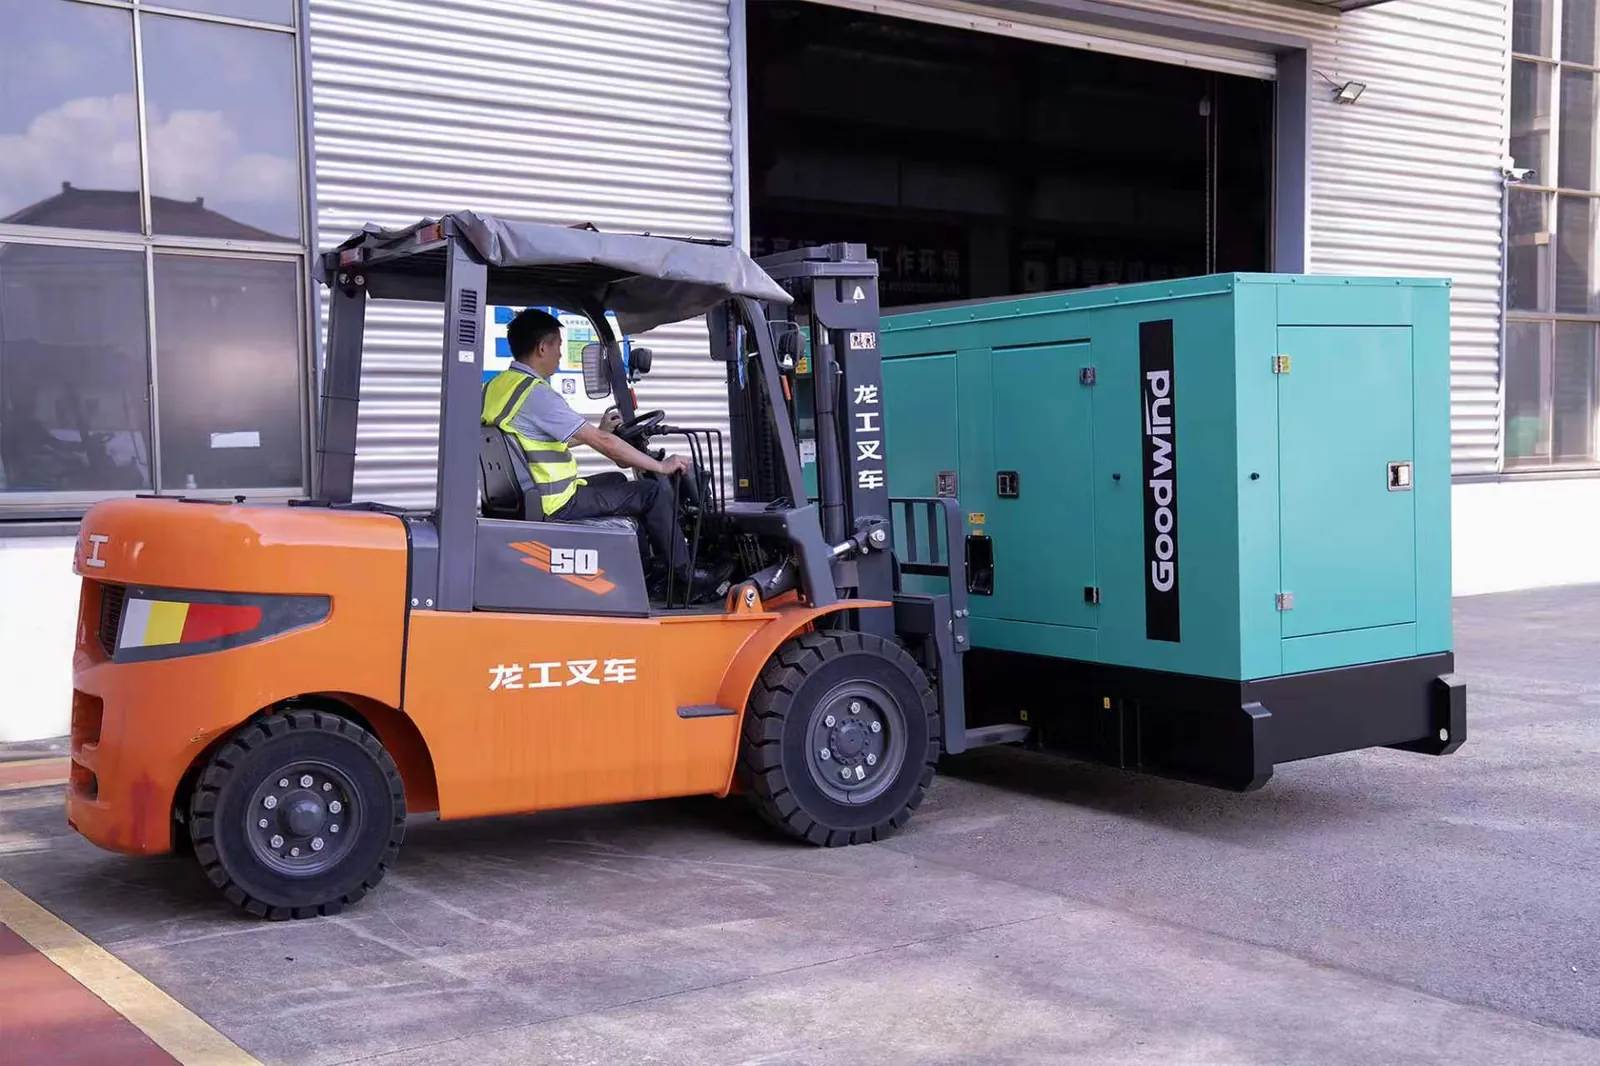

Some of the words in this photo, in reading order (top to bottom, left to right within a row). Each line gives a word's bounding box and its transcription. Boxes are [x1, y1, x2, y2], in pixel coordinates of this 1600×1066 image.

[853, 384, 884, 490] 龙工叉车
[1145, 370, 1175, 592] Goodwind
[551, 548, 598, 574] 50
[488, 658, 637, 691] 龙工叉车
